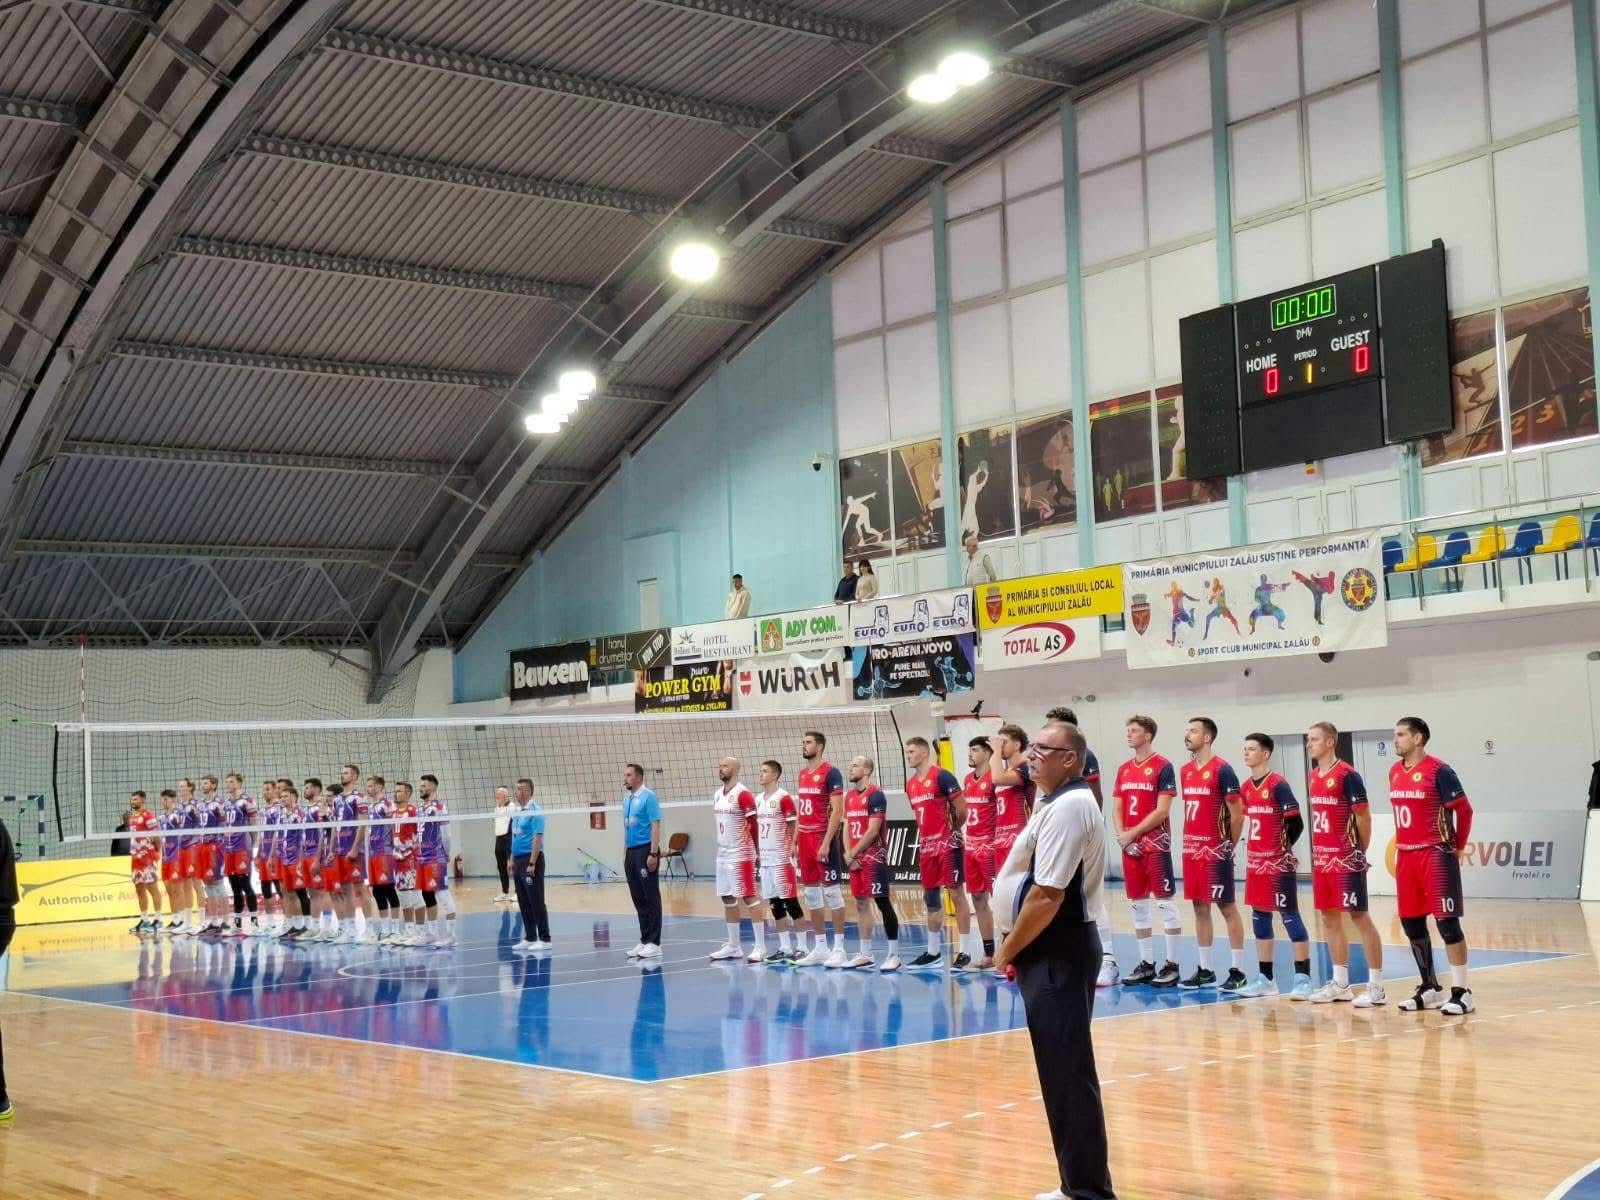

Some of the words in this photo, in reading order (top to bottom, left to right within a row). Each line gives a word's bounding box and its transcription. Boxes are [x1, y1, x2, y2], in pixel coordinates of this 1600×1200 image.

[1276, 289, 1331, 326] 00:00
[1330, 330, 1370, 351] GUEST
[1246, 353, 1278, 373] HOME
[1294, 349, 1317, 361] PERIOD
[1356, 347, 1368, 372] 0
[1266, 368, 1278, 394] 0
[1536, 404, 1554, 423] 3
[1172, 559, 1228, 575] MUNICIPIULUI
[1230, 554, 1258, 567] ZALĂU
[1006, 588, 1039, 602] PRIMĂRIA
[1050, 582, 1088, 596] CONSILIUL
[1090, 579, 1115, 591] LOCAL
[1008, 608, 1016, 617] AL
[1018, 602, 1066, 616] MUNICIPIULUI
[1068, 595, 1091, 609] ZALĂU
[785, 619, 808, 638] ADY
[810, 615, 836, 635] COM
[893, 622, 925, 632] EURO
[933, 617, 965, 628] EURO
[704, 634, 728, 646] HOTEL
[854, 627, 886, 637] EURO
[704, 645, 752, 657] RESTAURANT
[1004, 638, 1040, 656] TOTAL
[1045, 634, 1061, 651] AS
[1197, 646, 1218, 655] SPORT
[1221, 644, 1240, 653] CLUB
[1242, 640, 1282, 652] MUNICIPAL
[1284, 637, 1309, 648] ZALĂU
[513, 660, 588, 689] Baucem
[758, 662, 840, 694] WÜRTH
[644, 679, 690, 698] POWER
[692, 675, 721, 693] GYM
[800, 799, 813, 816] 28
[1129, 796, 1138, 816] 2
[1186, 800, 1200, 821] 77
[1313, 811, 1329, 833] 24
[1394, 805, 1412, 829] 10
[851, 821, 863, 839] 22
[1460, 841, 1554, 867] RVOLEI
[824, 870, 837, 881] 28
[953, 870, 959, 882] 7
[1512, 871, 1551, 879] frvolei.ro
[871, 883, 882, 894] 22
[1164, 879, 1171, 891] 2
[1211, 885, 1225, 899] 77
[38, 893, 113, 906] Automobile
[1275, 893, 1287, 907] 12
[1343, 892, 1358, 907] 24
[1441, 898, 1455, 912] 10
